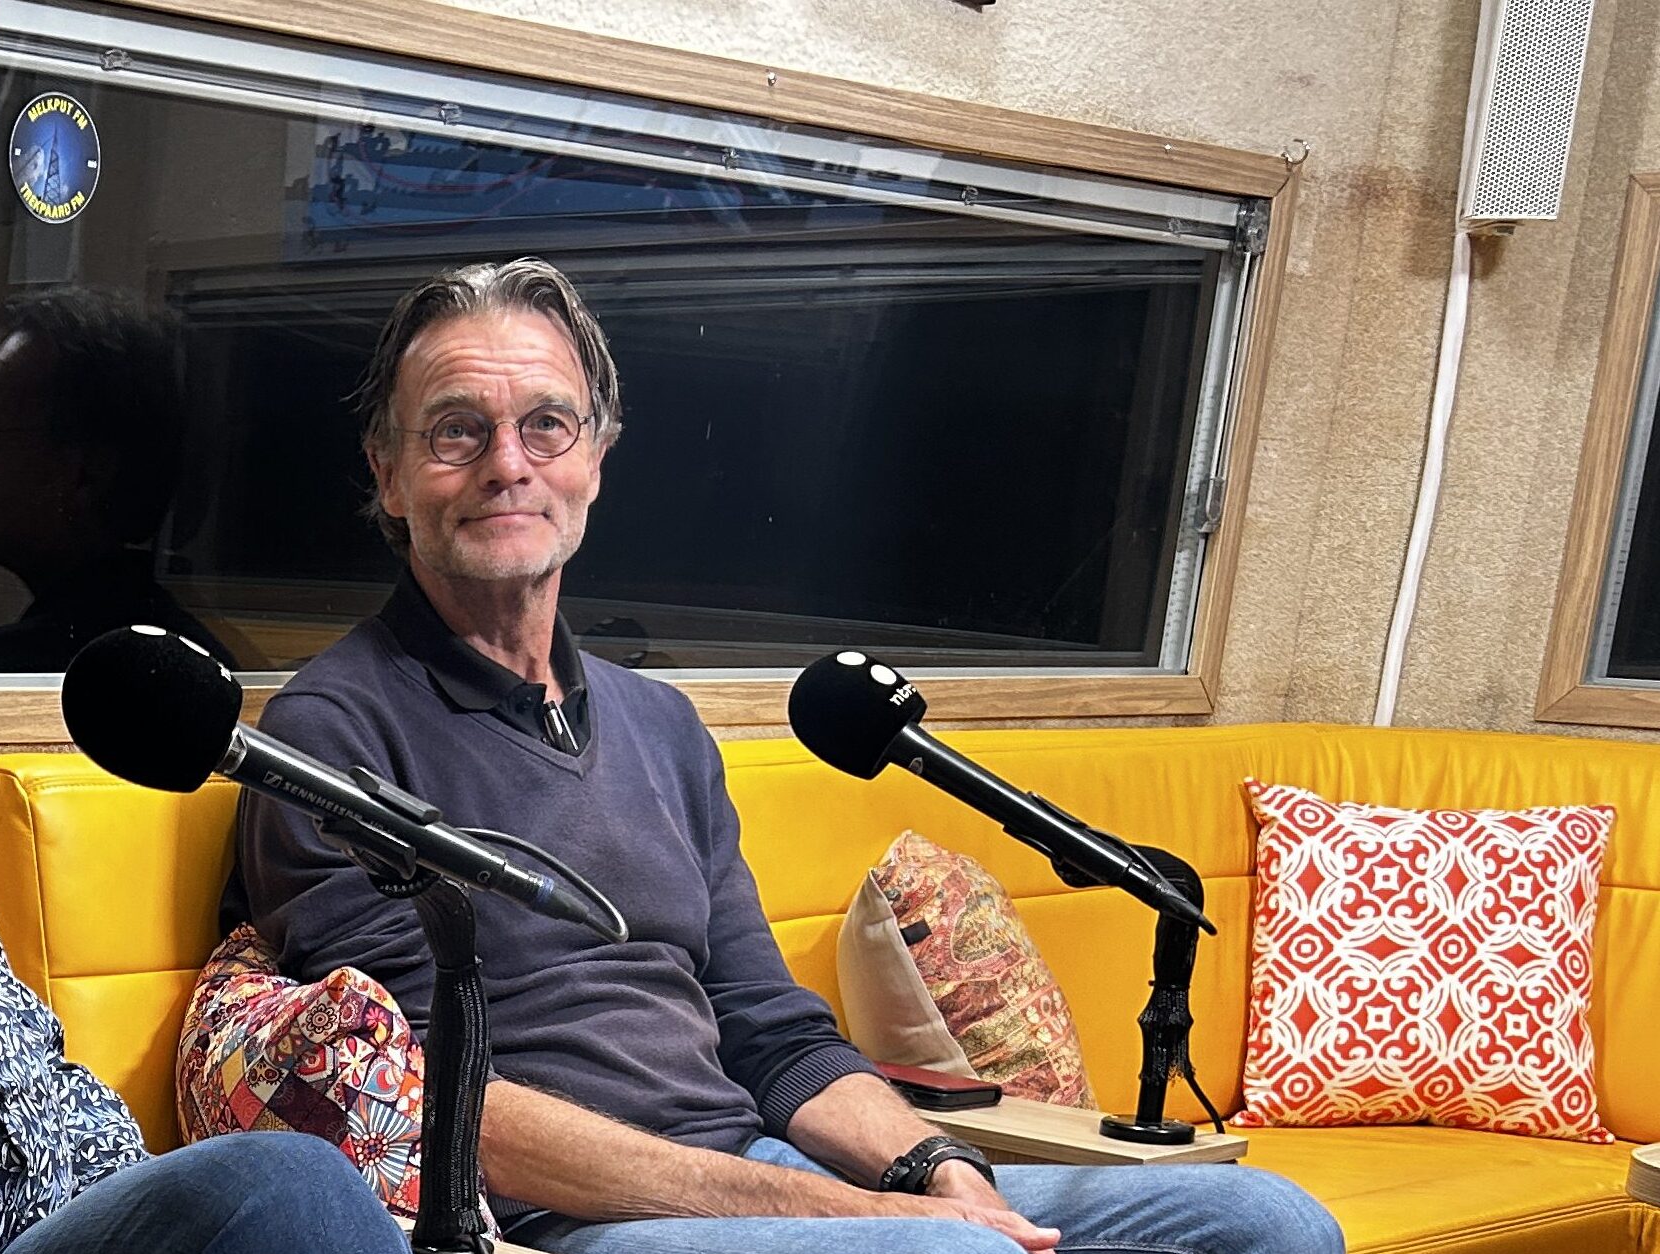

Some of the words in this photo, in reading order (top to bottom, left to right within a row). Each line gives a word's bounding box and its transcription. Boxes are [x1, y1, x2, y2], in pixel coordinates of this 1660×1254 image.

[27, 97, 74, 122] MELKPUT
[72, 109, 88, 130] FM
[20, 181, 71, 218] TREKPAARD
[70, 190, 85, 211] FM
